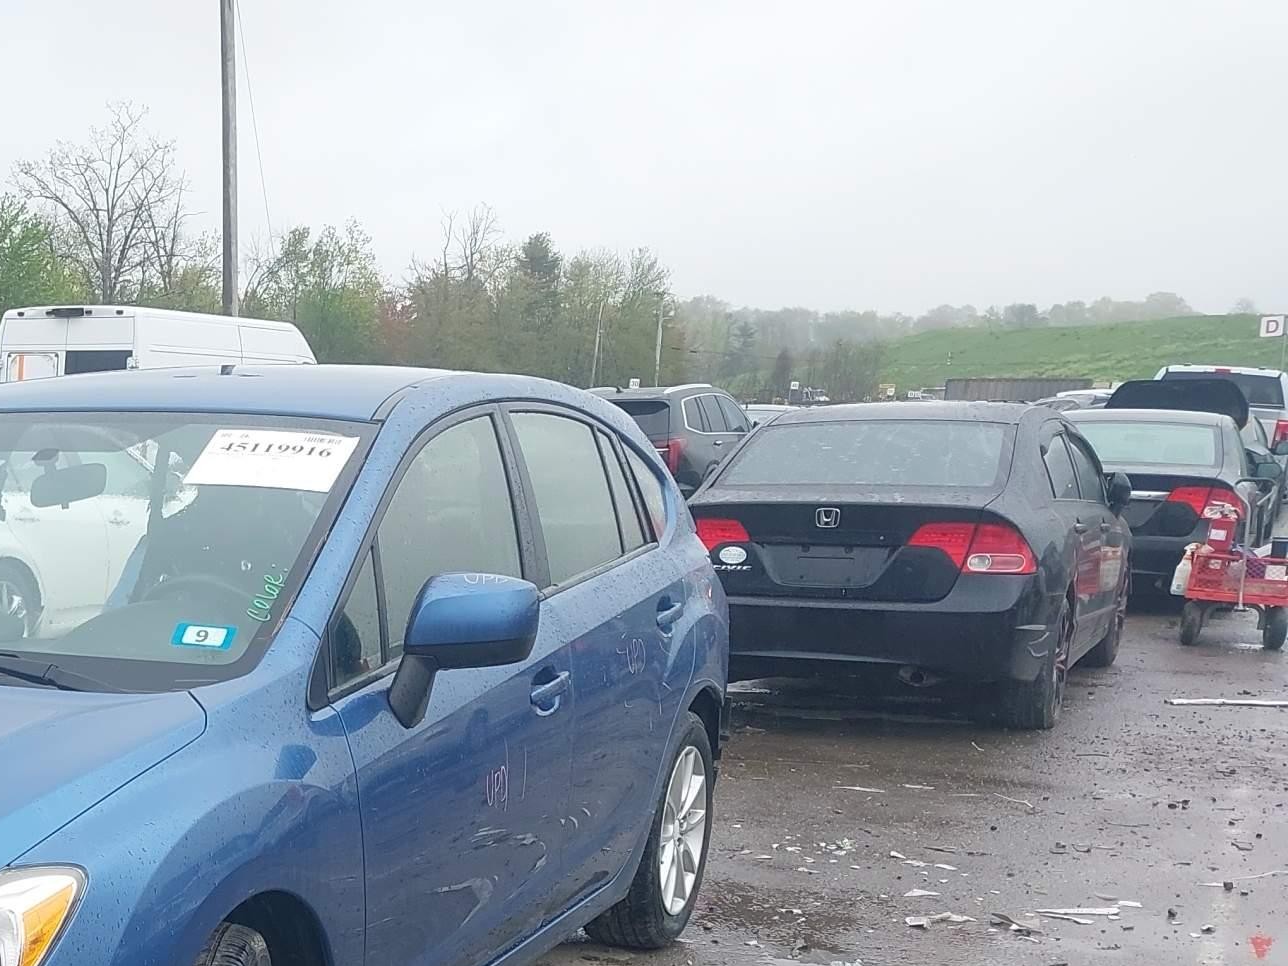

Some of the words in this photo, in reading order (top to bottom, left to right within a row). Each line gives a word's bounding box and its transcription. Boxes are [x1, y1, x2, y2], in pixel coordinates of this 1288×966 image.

[1266, 319, 1280, 334] D
[220, 442, 332, 457] 45119916
[195, 629, 209, 643] 9
